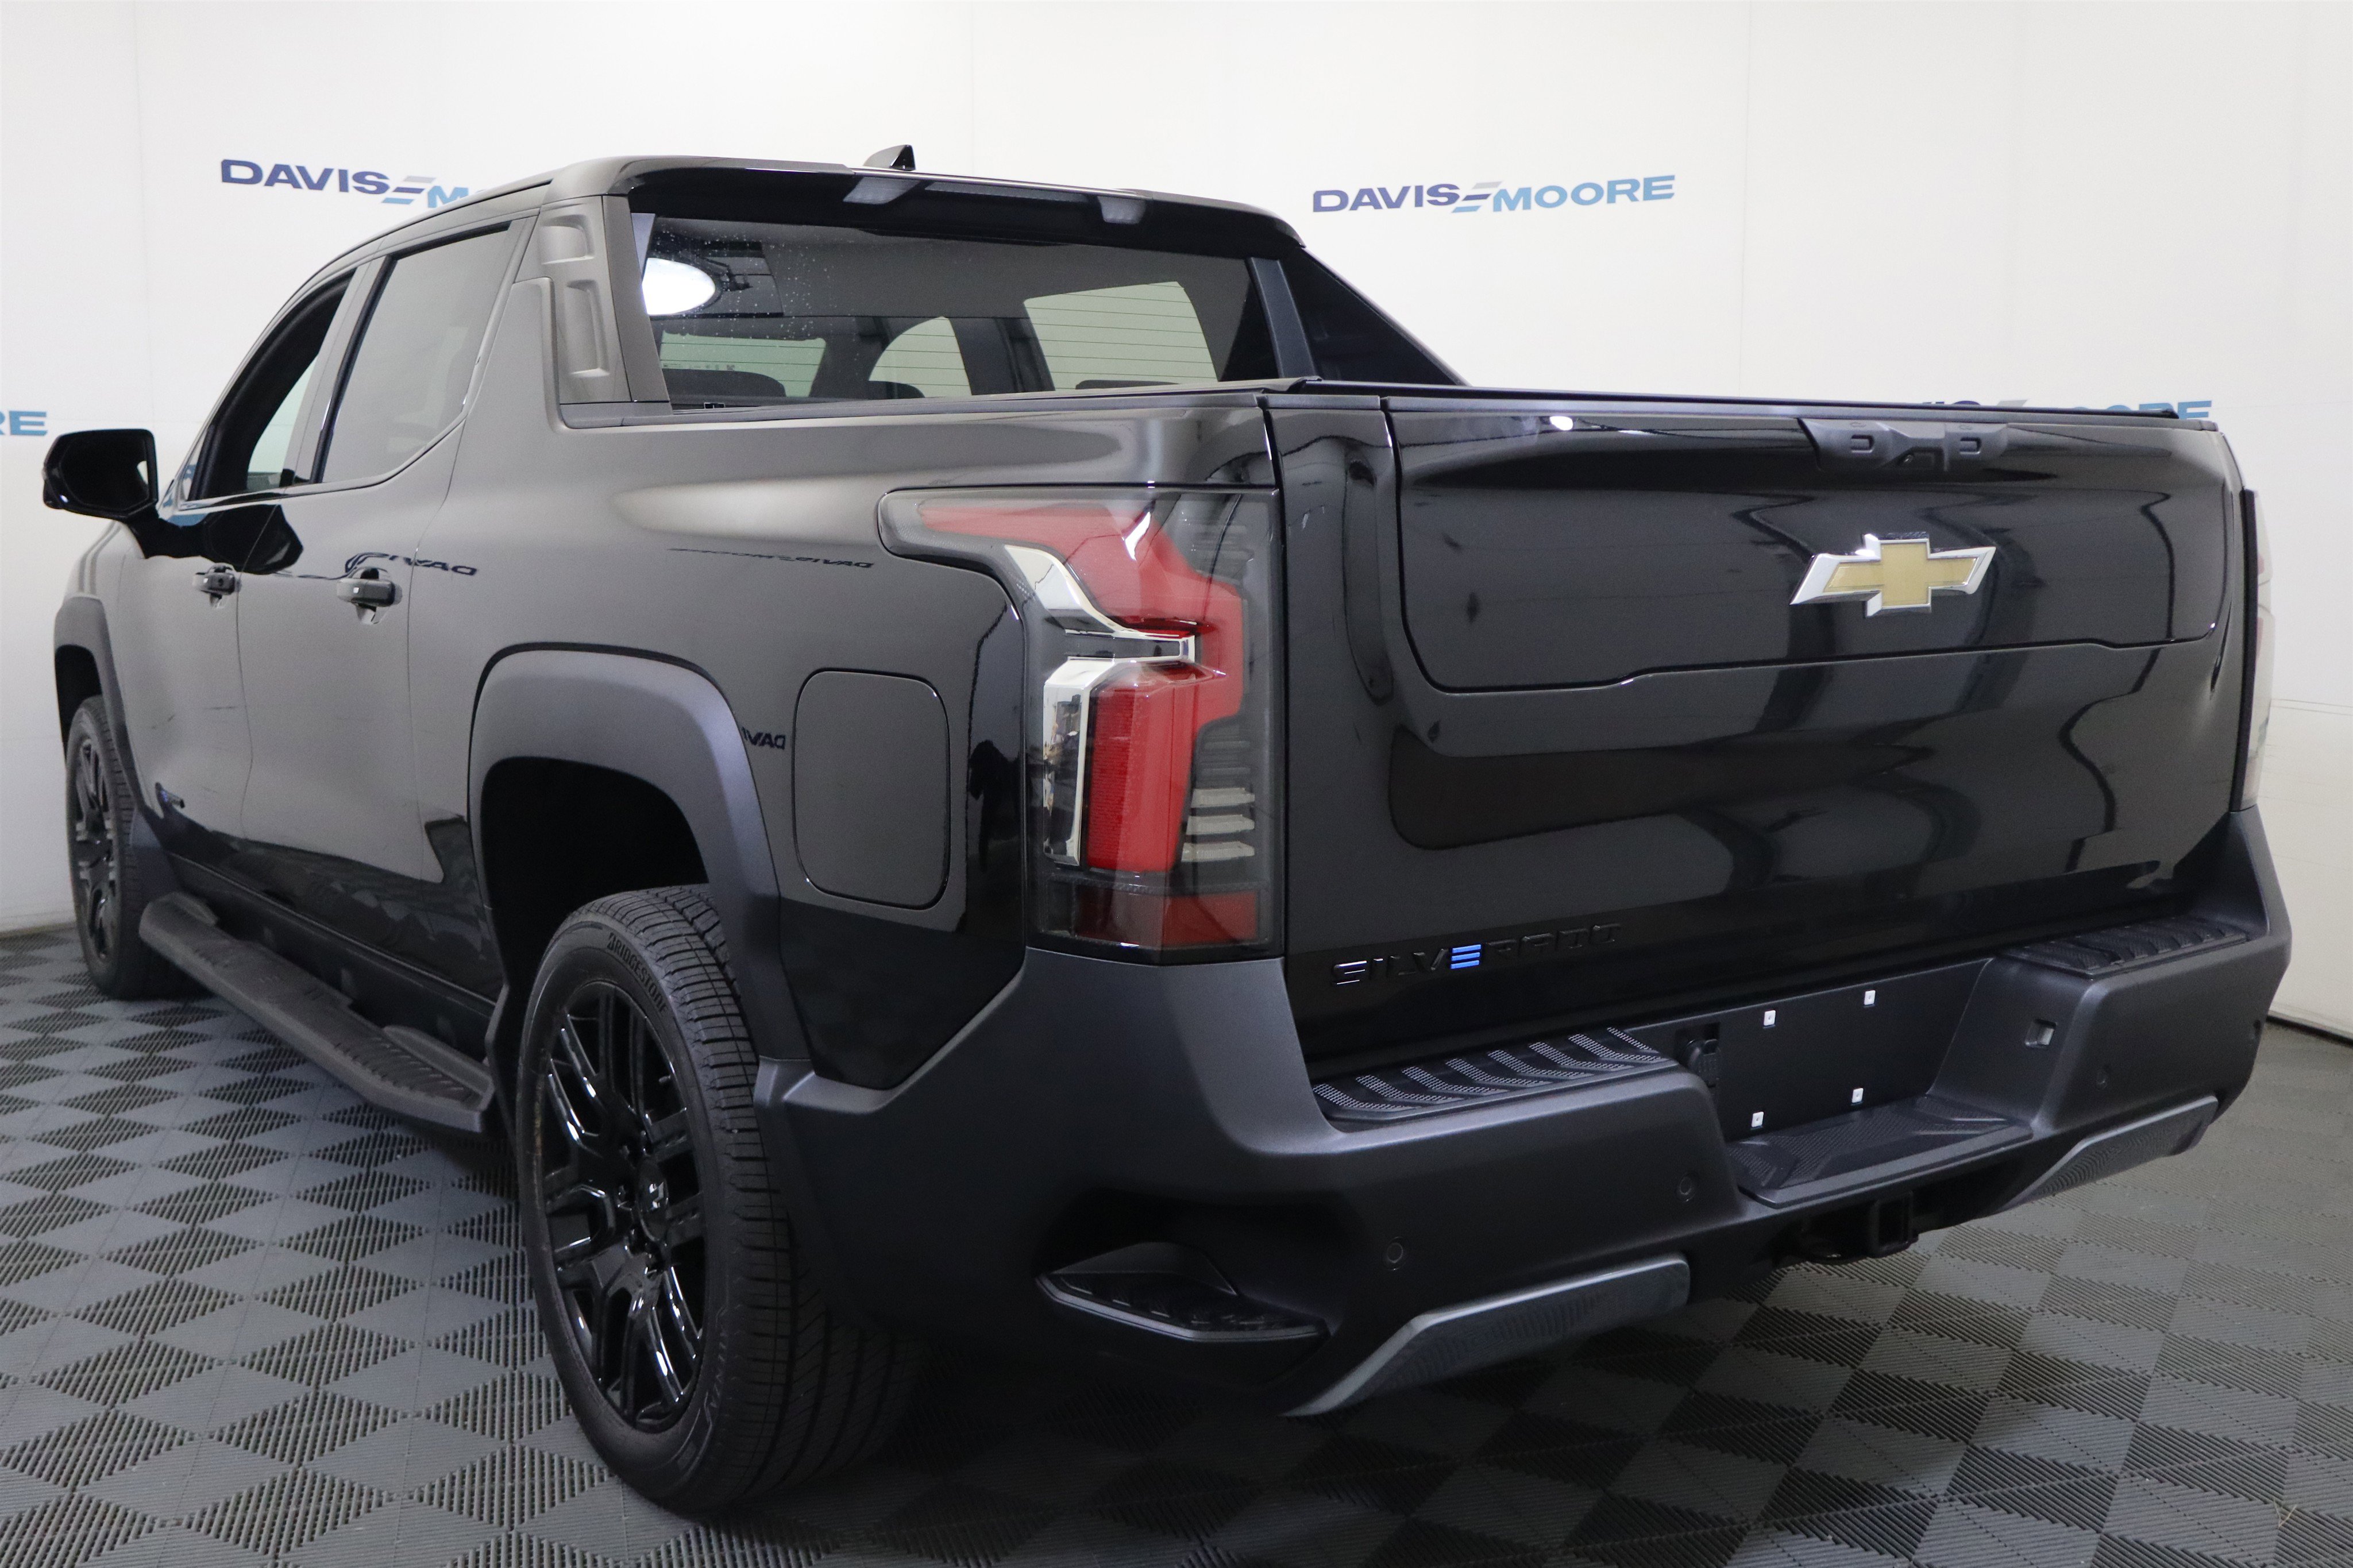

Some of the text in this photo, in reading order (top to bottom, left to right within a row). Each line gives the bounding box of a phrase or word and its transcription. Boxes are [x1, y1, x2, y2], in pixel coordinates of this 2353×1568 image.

[221, 159, 390, 194] DAVIS
[1313, 175, 1676, 213] DAVIS MOORE
[0, 410, 48, 436] E
[607, 932, 669, 1013] BRIDGESTONE
